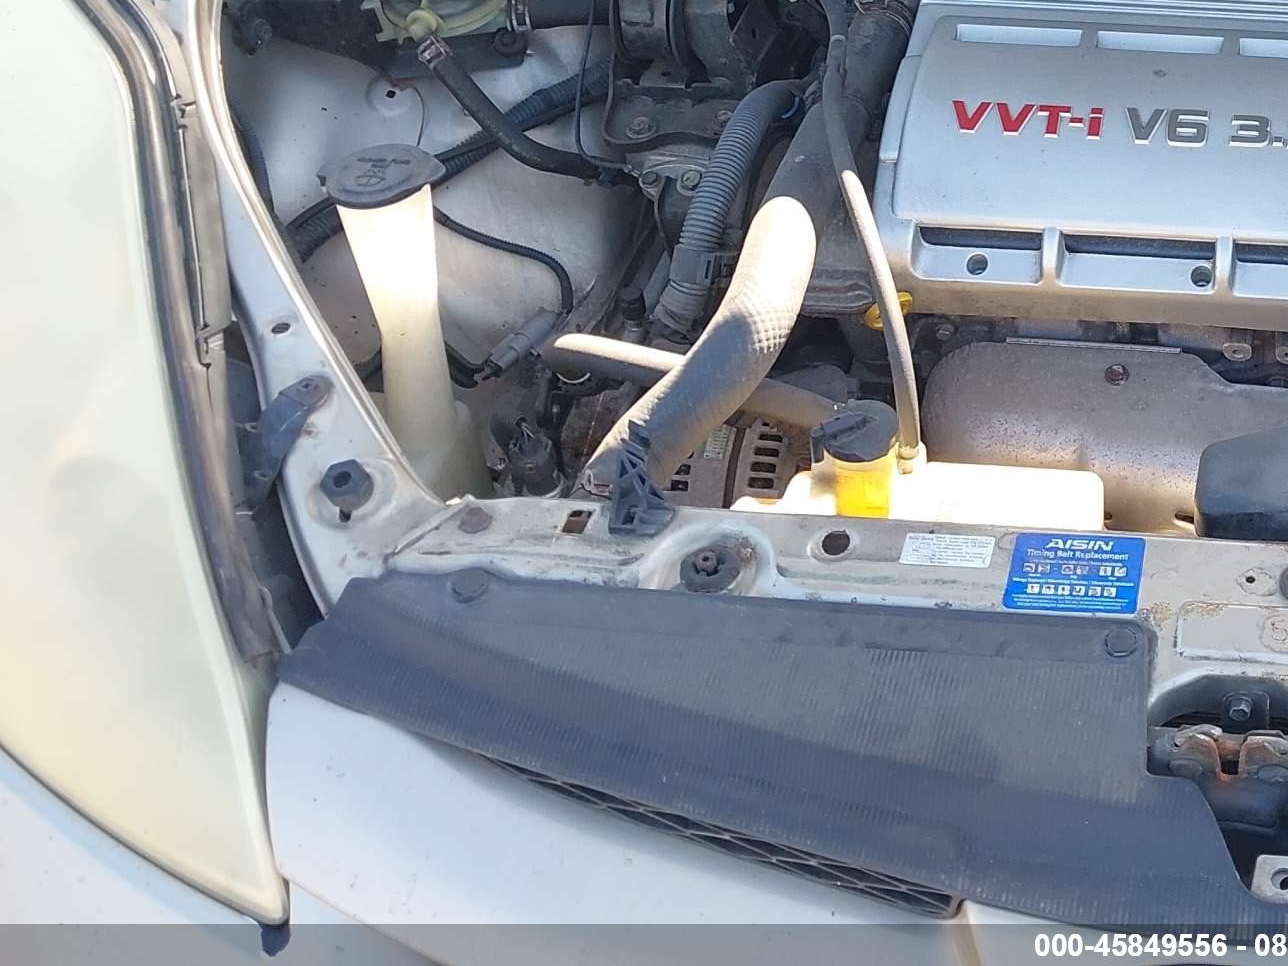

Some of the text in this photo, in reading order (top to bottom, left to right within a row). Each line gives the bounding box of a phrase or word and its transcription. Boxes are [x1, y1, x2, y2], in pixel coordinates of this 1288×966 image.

[952, 99, 1104, 140] VVT-i
[1124, 106, 1209, 147] V6
[1045, 538, 1114, 551] AISIN
[1027, 549, 1129, 561] Timing Belt Replacement
